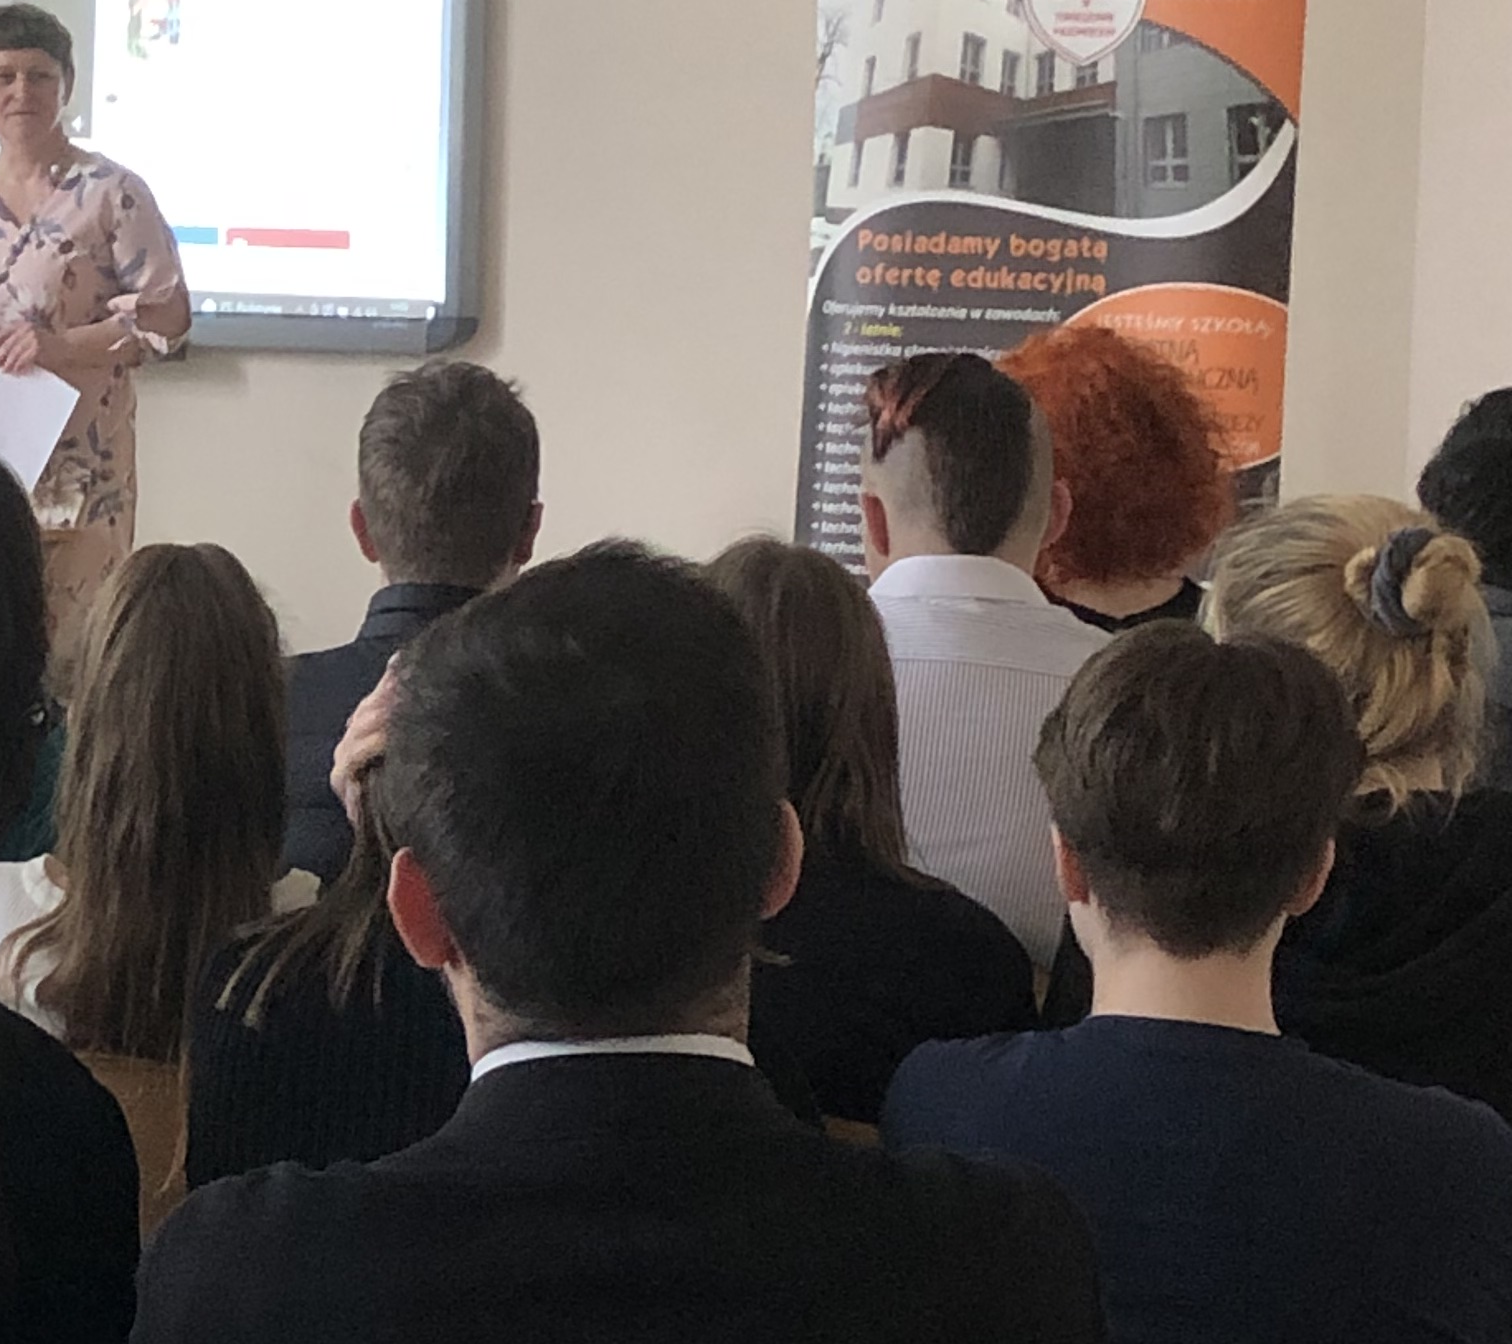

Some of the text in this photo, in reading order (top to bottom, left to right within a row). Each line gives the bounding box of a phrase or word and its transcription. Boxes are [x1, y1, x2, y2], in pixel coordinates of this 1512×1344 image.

[857, 228, 1109, 264] Posiadamy bogatą
[855, 263, 1108, 297] ofertę edukacyjną
[821, 299, 886, 320] Oferujemy
[969, 307, 984, 321] w
[1096, 311, 1185, 334] JESTEŚMY
